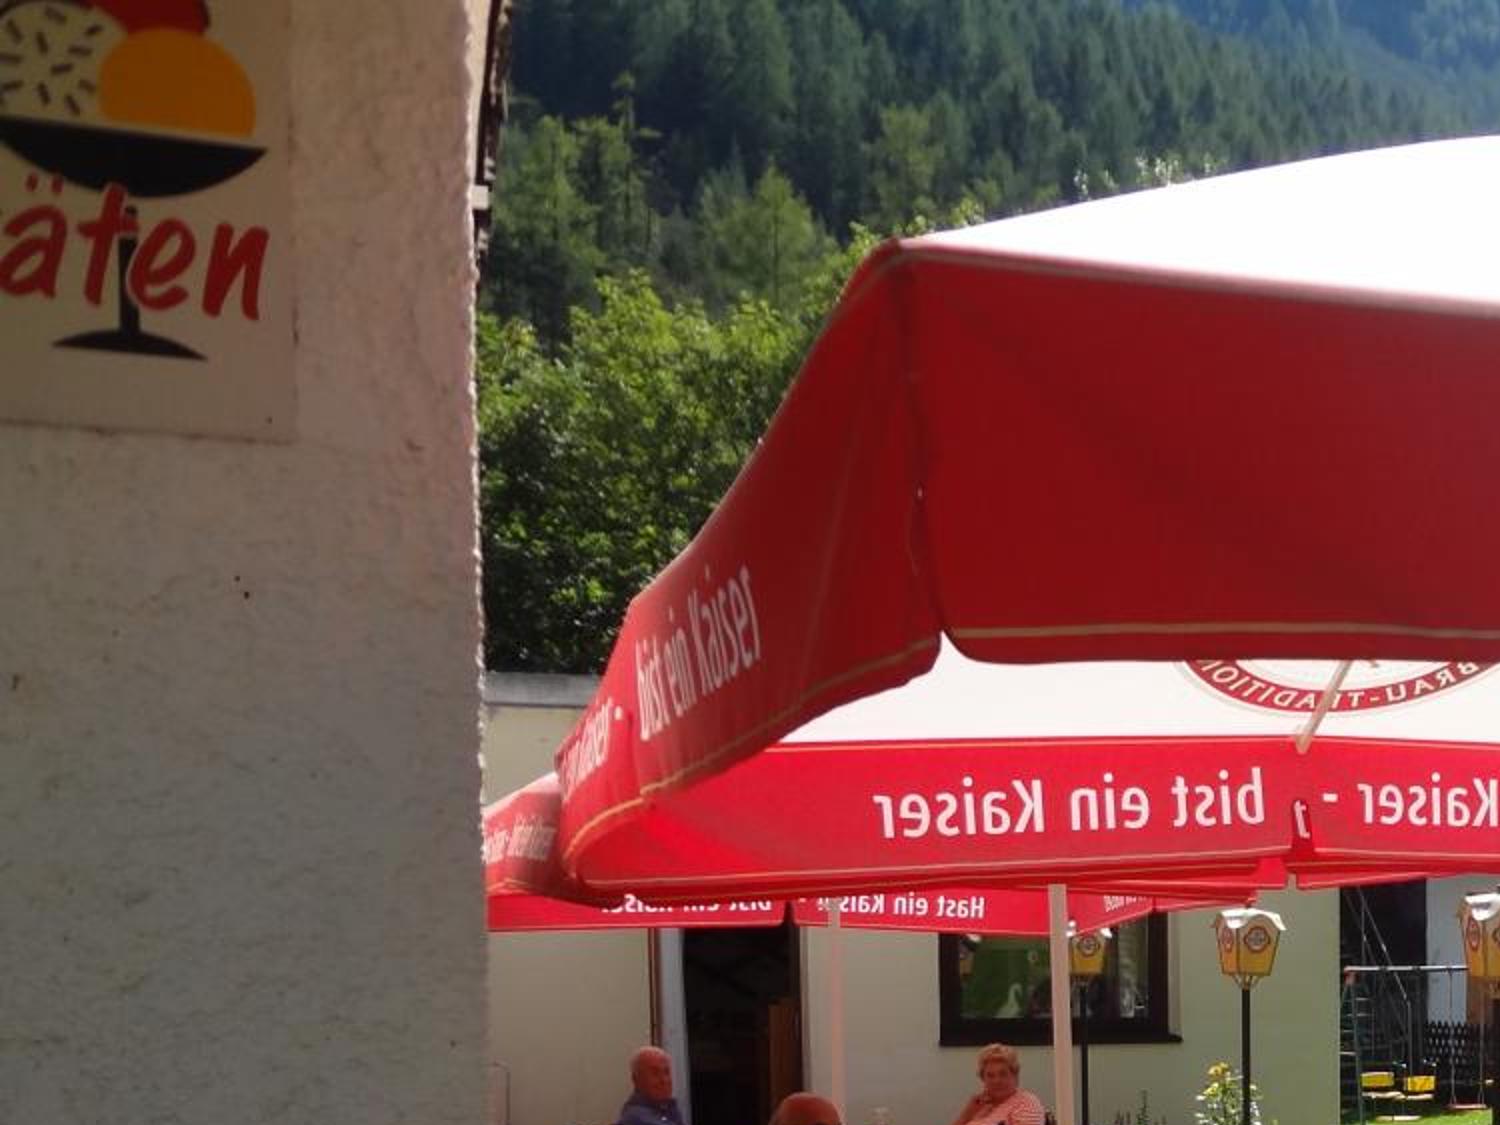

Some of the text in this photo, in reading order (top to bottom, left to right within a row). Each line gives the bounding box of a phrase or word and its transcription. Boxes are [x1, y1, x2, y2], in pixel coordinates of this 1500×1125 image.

[0, 172, 269, 320] äten
[635, 636, 671, 742] bist
[687, 564, 761, 696] Kaiser
